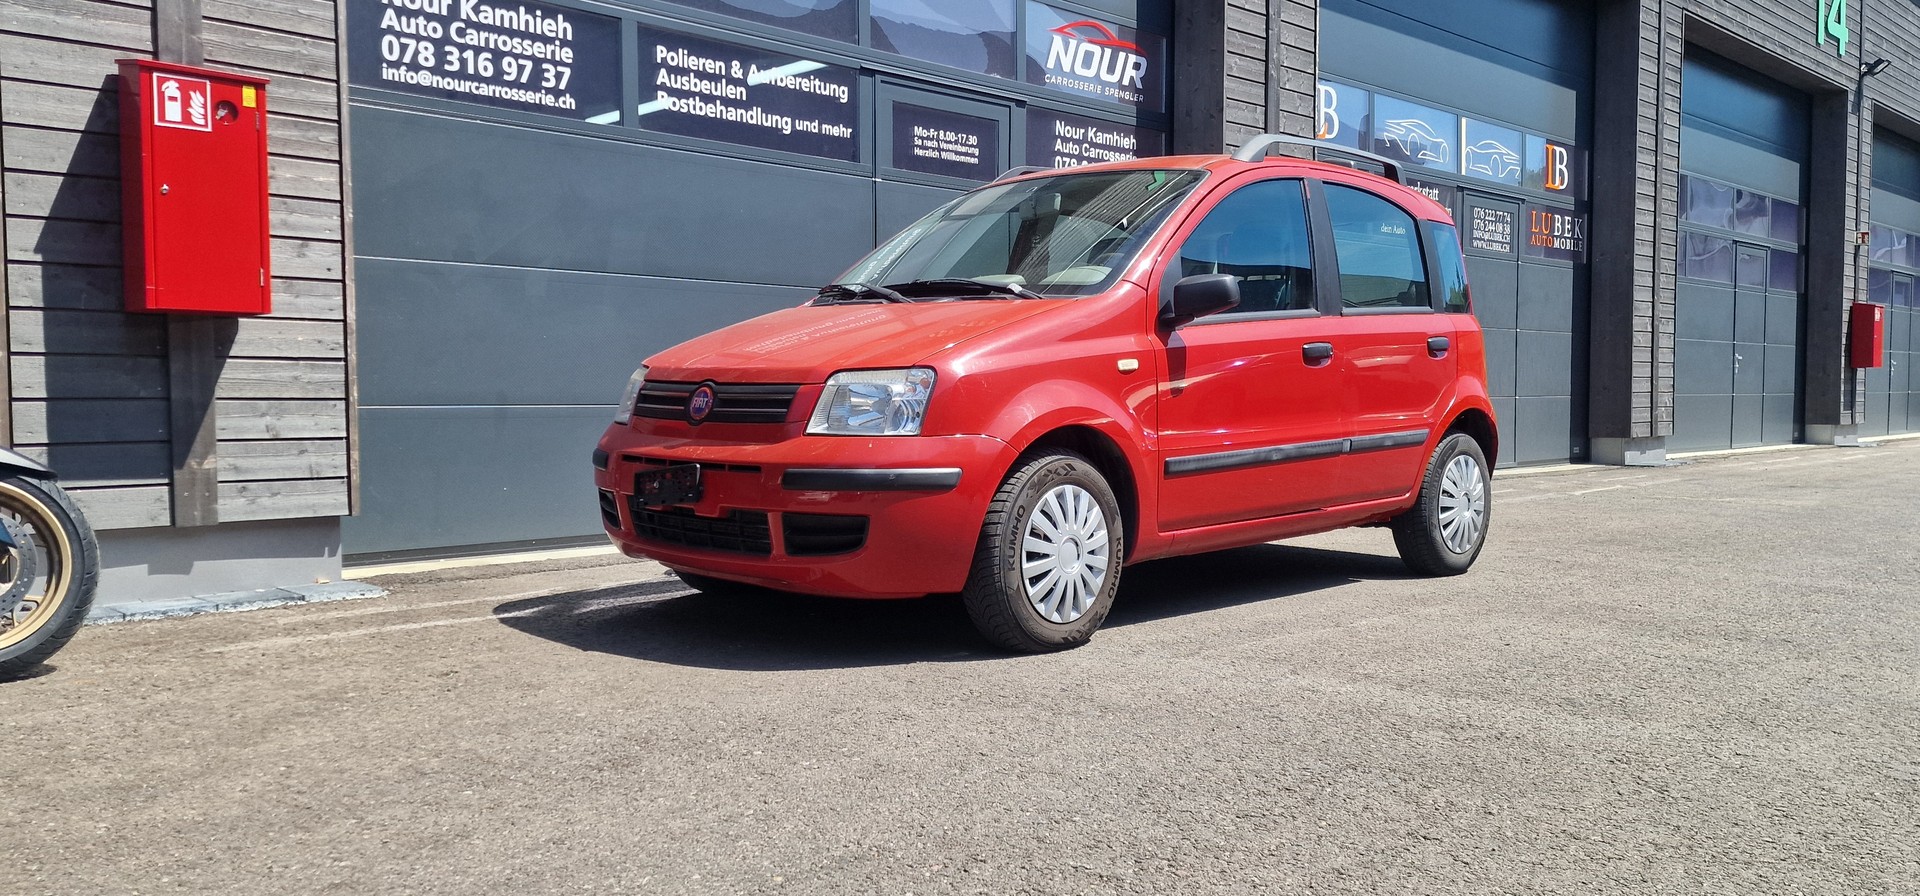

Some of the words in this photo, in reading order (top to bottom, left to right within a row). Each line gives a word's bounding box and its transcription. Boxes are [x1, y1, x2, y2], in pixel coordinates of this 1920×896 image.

[381, 0, 452, 16] our
[460, 0, 573, 40] Kamhieh
[380, 8, 443, 38] Auto
[450, 21, 574, 63] Carrosserie
[382, 34, 435, 68] 078
[444, 45, 494, 77] 316
[502, 56, 533, 83] 97
[541, 63, 572, 91] 37
[656, 44, 726, 76] Polieren
[731, 60, 744, 80] &
[1046, 34, 1148, 89] NOUR
[382, 63, 576, 110] info@nourcarrosserie.ch
[656, 68, 747, 101] Ausbeulen
[1044, 74, 1102, 94] CARROSSERIE
[1104, 87, 1144, 103] SPENGLER
[1317, 84, 1340, 139] B
[795, 119, 819, 134] und
[821, 123, 853, 139] mehr
[914, 126, 938, 139] Mo-Fr
[939, 130, 978, 146] 8.00-17.30
[1055, 120, 1085, 140] Nour
[1088, 126, 1137, 150] Kamhieh
[914, 137, 922, 146] Sa
[923, 139, 938, 149] nach
[939, 141, 979, 157] Vereinbarung
[914, 147, 939, 159] Herzlich
[940, 151, 979, 165] Willkommen
[1054, 138, 1080, 155] Auto
[1473, 207, 1485, 219] 076
[1485, 209, 1496, 221] 222
[1496, 211, 1503, 222] 77
[1504, 212, 1511, 224] 74
[1473, 219, 1485, 231] 076
[1531, 210, 1583, 239] LUBEK
[1530, 234, 1583, 252] AUTOMOBILE
[692, 397, 709, 409] FIAT
[1006, 504, 1026, 572] KUMHO
[1107, 536, 1123, 600] KUMHO
